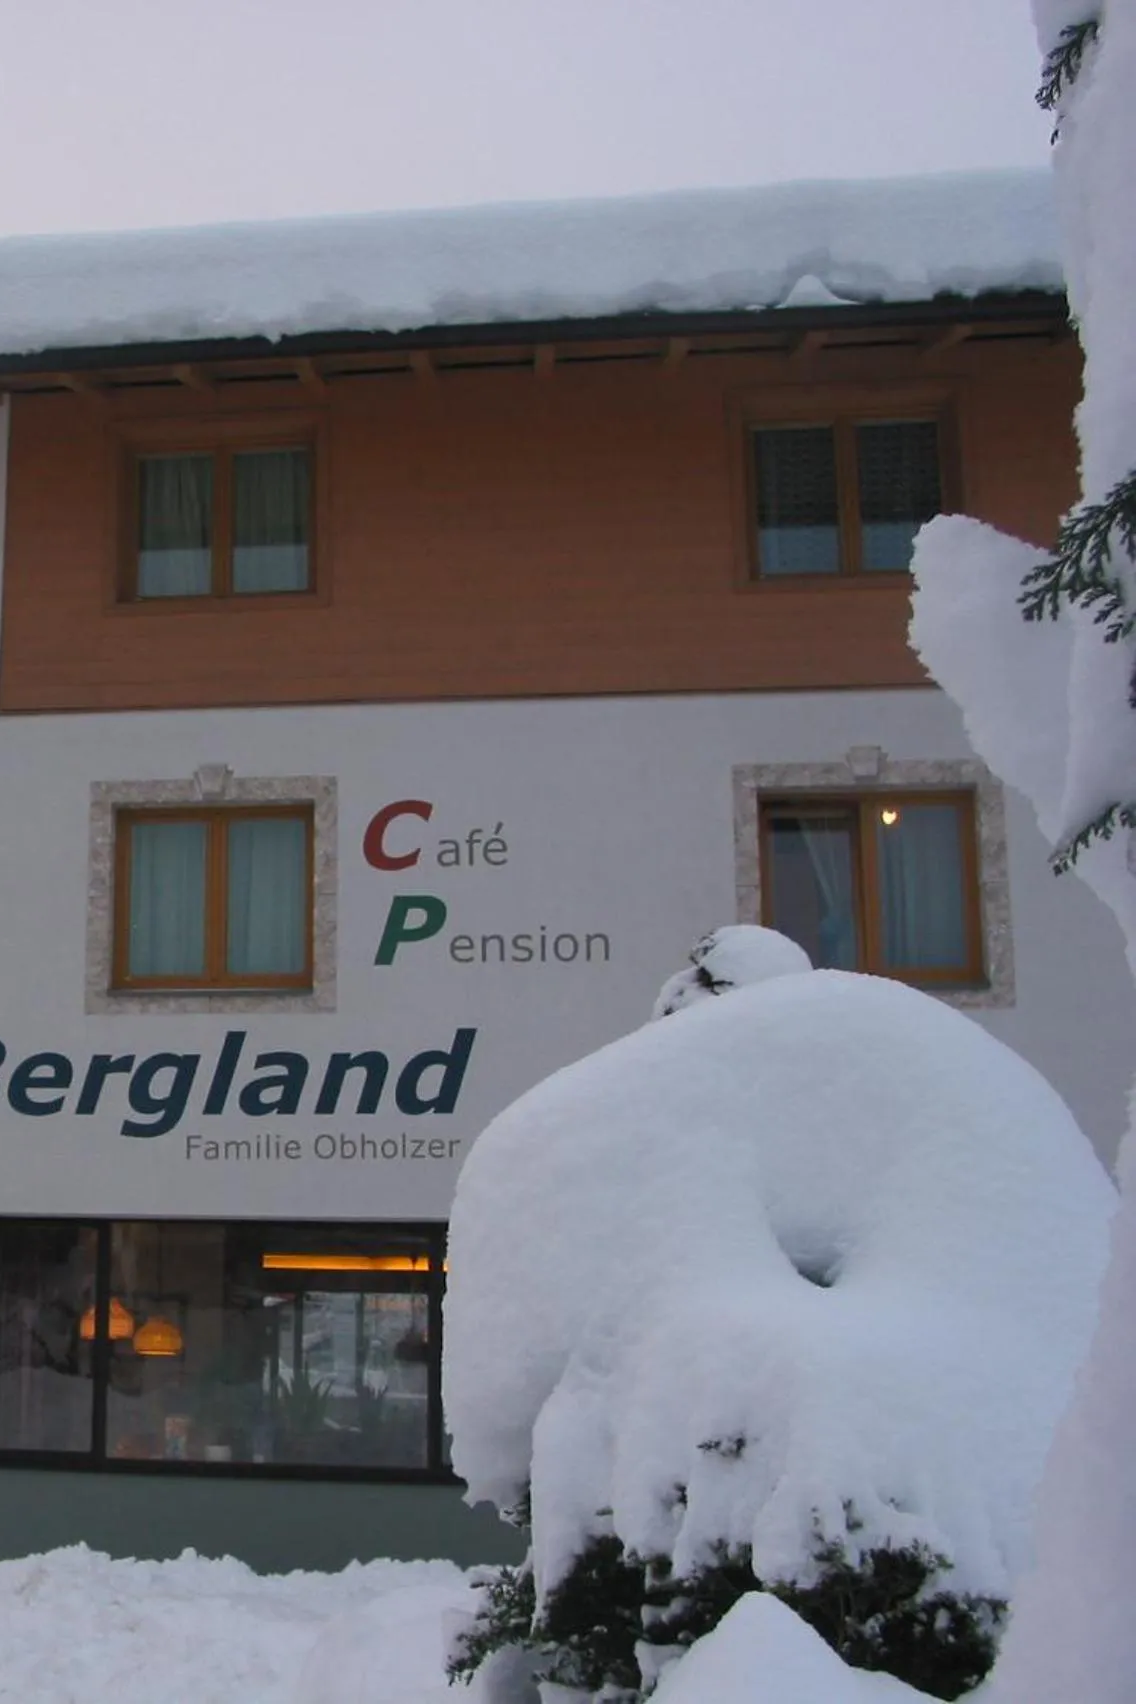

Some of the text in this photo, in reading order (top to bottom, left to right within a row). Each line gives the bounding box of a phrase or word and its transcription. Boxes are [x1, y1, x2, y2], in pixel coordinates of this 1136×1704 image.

[363, 799, 508, 871] Café
[374, 894, 610, 966] Pension
[185, 1133, 461, 1161] Familie Obholzer
